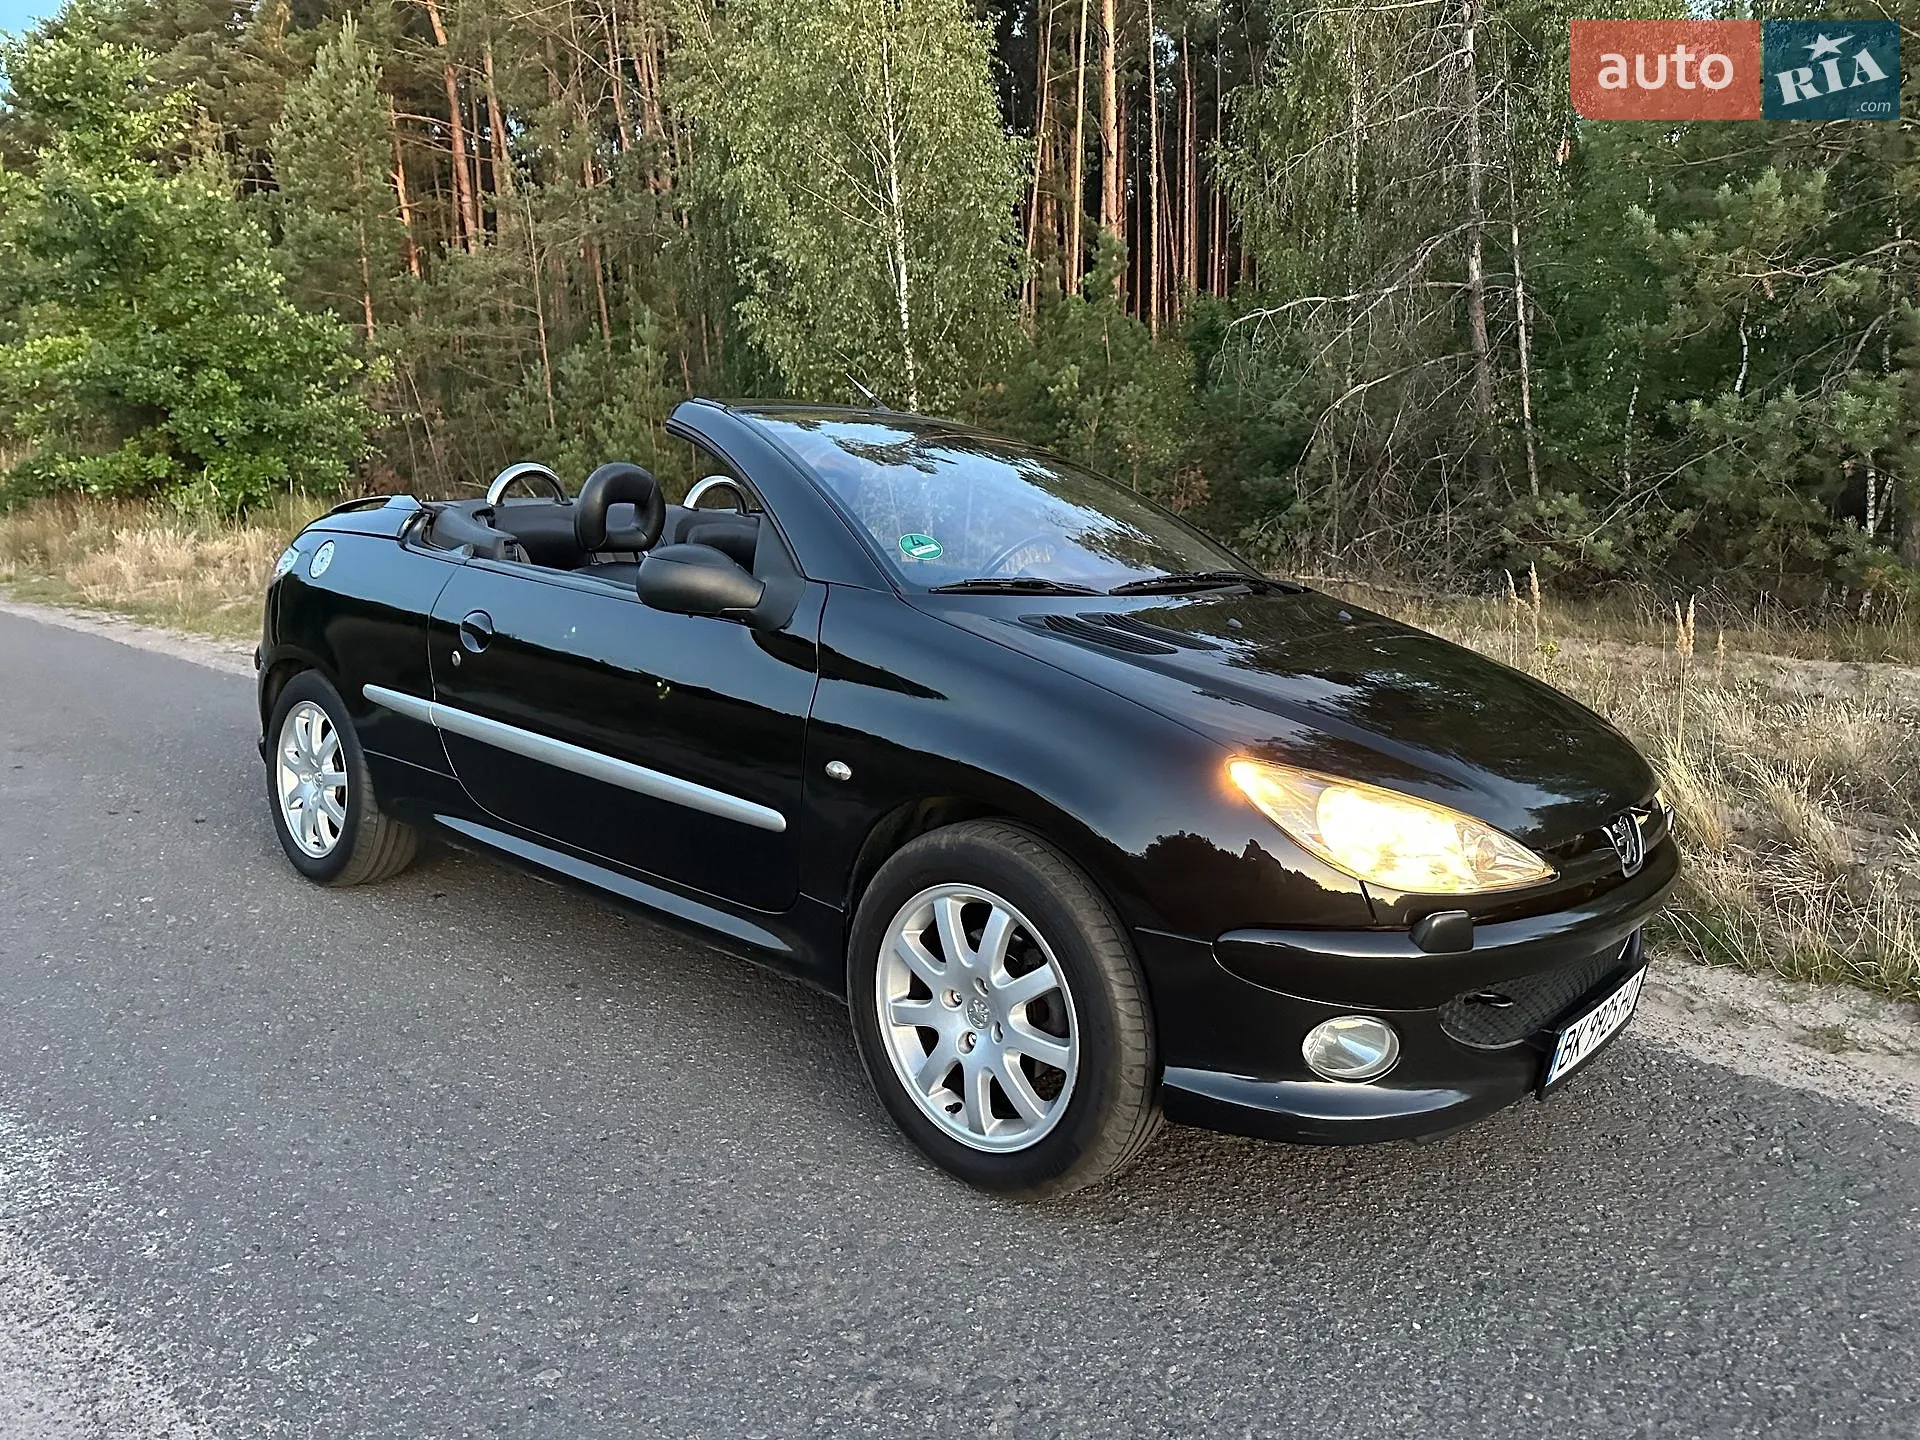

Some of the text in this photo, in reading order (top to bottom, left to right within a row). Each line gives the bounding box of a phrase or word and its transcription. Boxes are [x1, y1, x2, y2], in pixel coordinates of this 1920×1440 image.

[910, 535, 925, 547] 4
[1557, 1017, 1591, 1072] BK
[1583, 990, 1623, 1052] 9925
